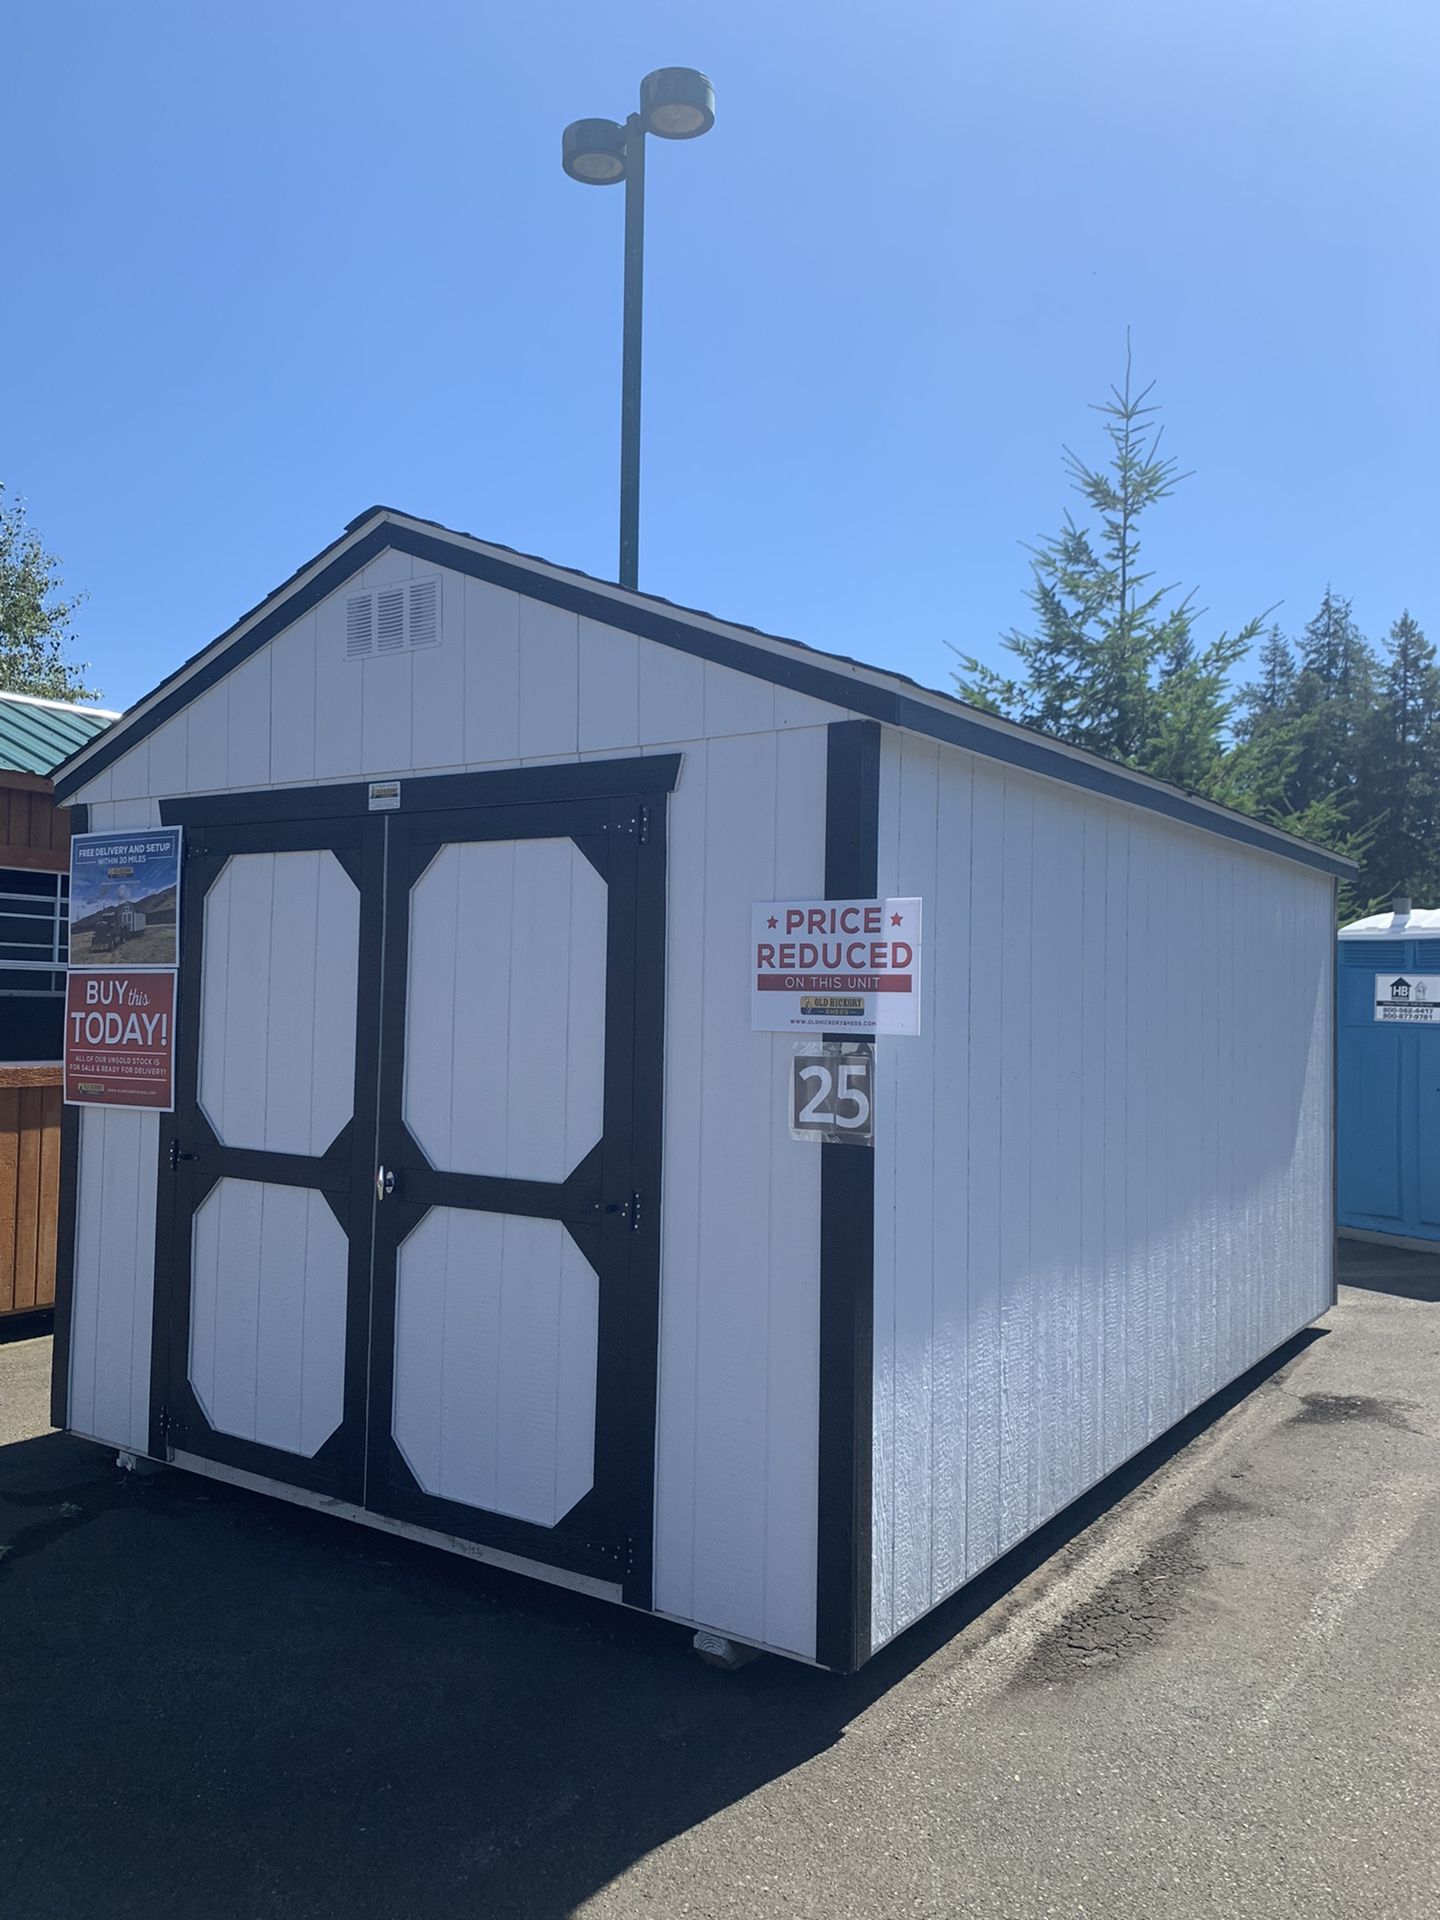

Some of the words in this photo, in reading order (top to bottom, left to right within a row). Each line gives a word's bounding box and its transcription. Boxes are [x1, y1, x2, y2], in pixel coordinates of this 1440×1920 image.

[79, 848, 95, 857] FREE
[95, 845, 128, 856] DELIVERY
[128, 844, 145, 854] AND
[146, 842, 171, 853] SETUP
[98, 856, 119, 865] WITHIN
[128, 855, 146, 863] MILES
[786, 907, 882, 935] PRICE
[757, 941, 913, 969] REDUCED
[784, 976, 804, 989] ON
[810, 976, 842, 989] THIS
[848, 976, 881, 989] UNIT
[86, 980, 128, 1005] BUY
[128, 988, 150, 1006] this
[1393, 985, 1409, 996] HB
[814, 998, 829, 1007] OLD
[829, 998, 862, 1008] HICKORY
[71, 1012, 167, 1047] TODAY!
[107, 1056, 131, 1065] UNSOLD
[153, 1058, 160, 1066] IS
[81, 1064, 95, 1072] SALE
[101, 1065, 119, 1073] READY
[121, 1066, 133, 1074] FOR
[799, 1064, 870, 1129] 25
